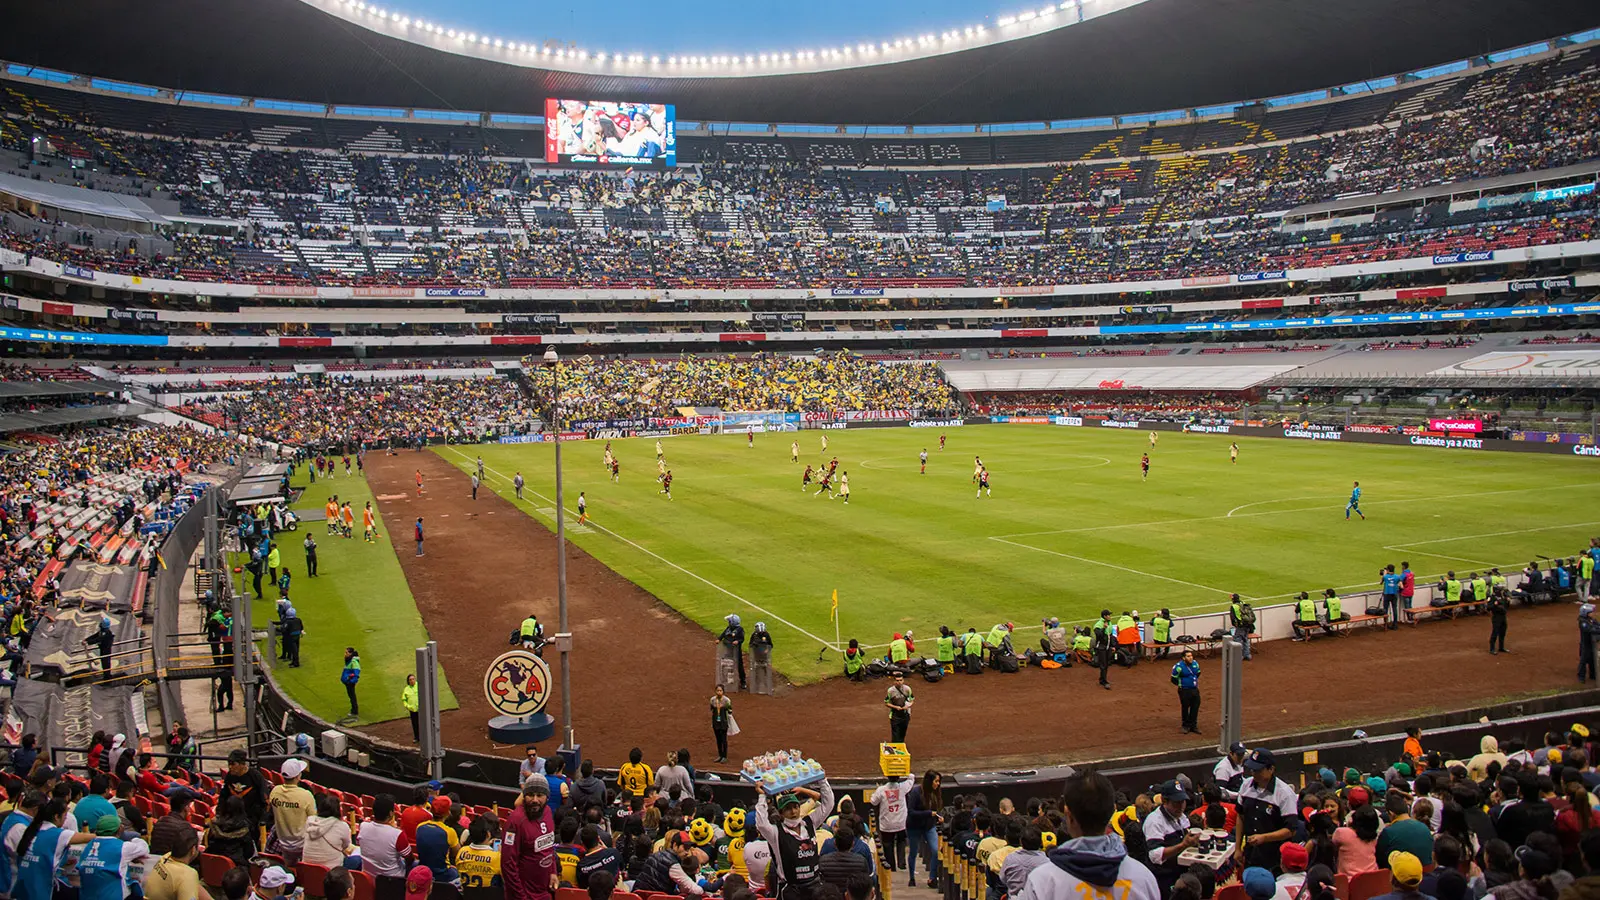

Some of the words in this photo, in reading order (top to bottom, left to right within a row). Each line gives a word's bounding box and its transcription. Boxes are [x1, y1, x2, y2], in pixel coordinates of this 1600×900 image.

[1434, 254, 1459, 264] Comex
[1464, 251, 1491, 261] Comex
[1239, 272, 1260, 281] Comex
[1262, 270, 1284, 279] Comex
[1511, 281, 1537, 292] Corona
[1542, 279, 1570, 289] Corona
[427, 288, 452, 296] Comex
[458, 288, 485, 296] Comex
[1319, 294, 1356, 303] caliente.mx
[112, 309, 132, 319] Corona
[135, 310, 156, 320] Corona
[1146, 306, 1169, 314] Corona
[505, 314, 529, 322] Corona
[755, 313, 777, 321] Corona
[781, 313, 803, 321] Corona
[595, 430, 622, 439] UNION
[1284, 429, 1312, 438] Cámbiate
[1312, 432, 1320, 440] ya
[1325, 431, 1341, 439] AT&T
[1410, 435, 1445, 446] Cámbiate
[1446, 439, 1455, 448] ya
[1462, 439, 1483, 448] AT&T
[630, 776, 637, 790] 9
[271, 797, 299, 809] Corona
[888, 805, 899, 813] 57
[540, 822, 547, 834] S
[460, 851, 492, 863] Corona
